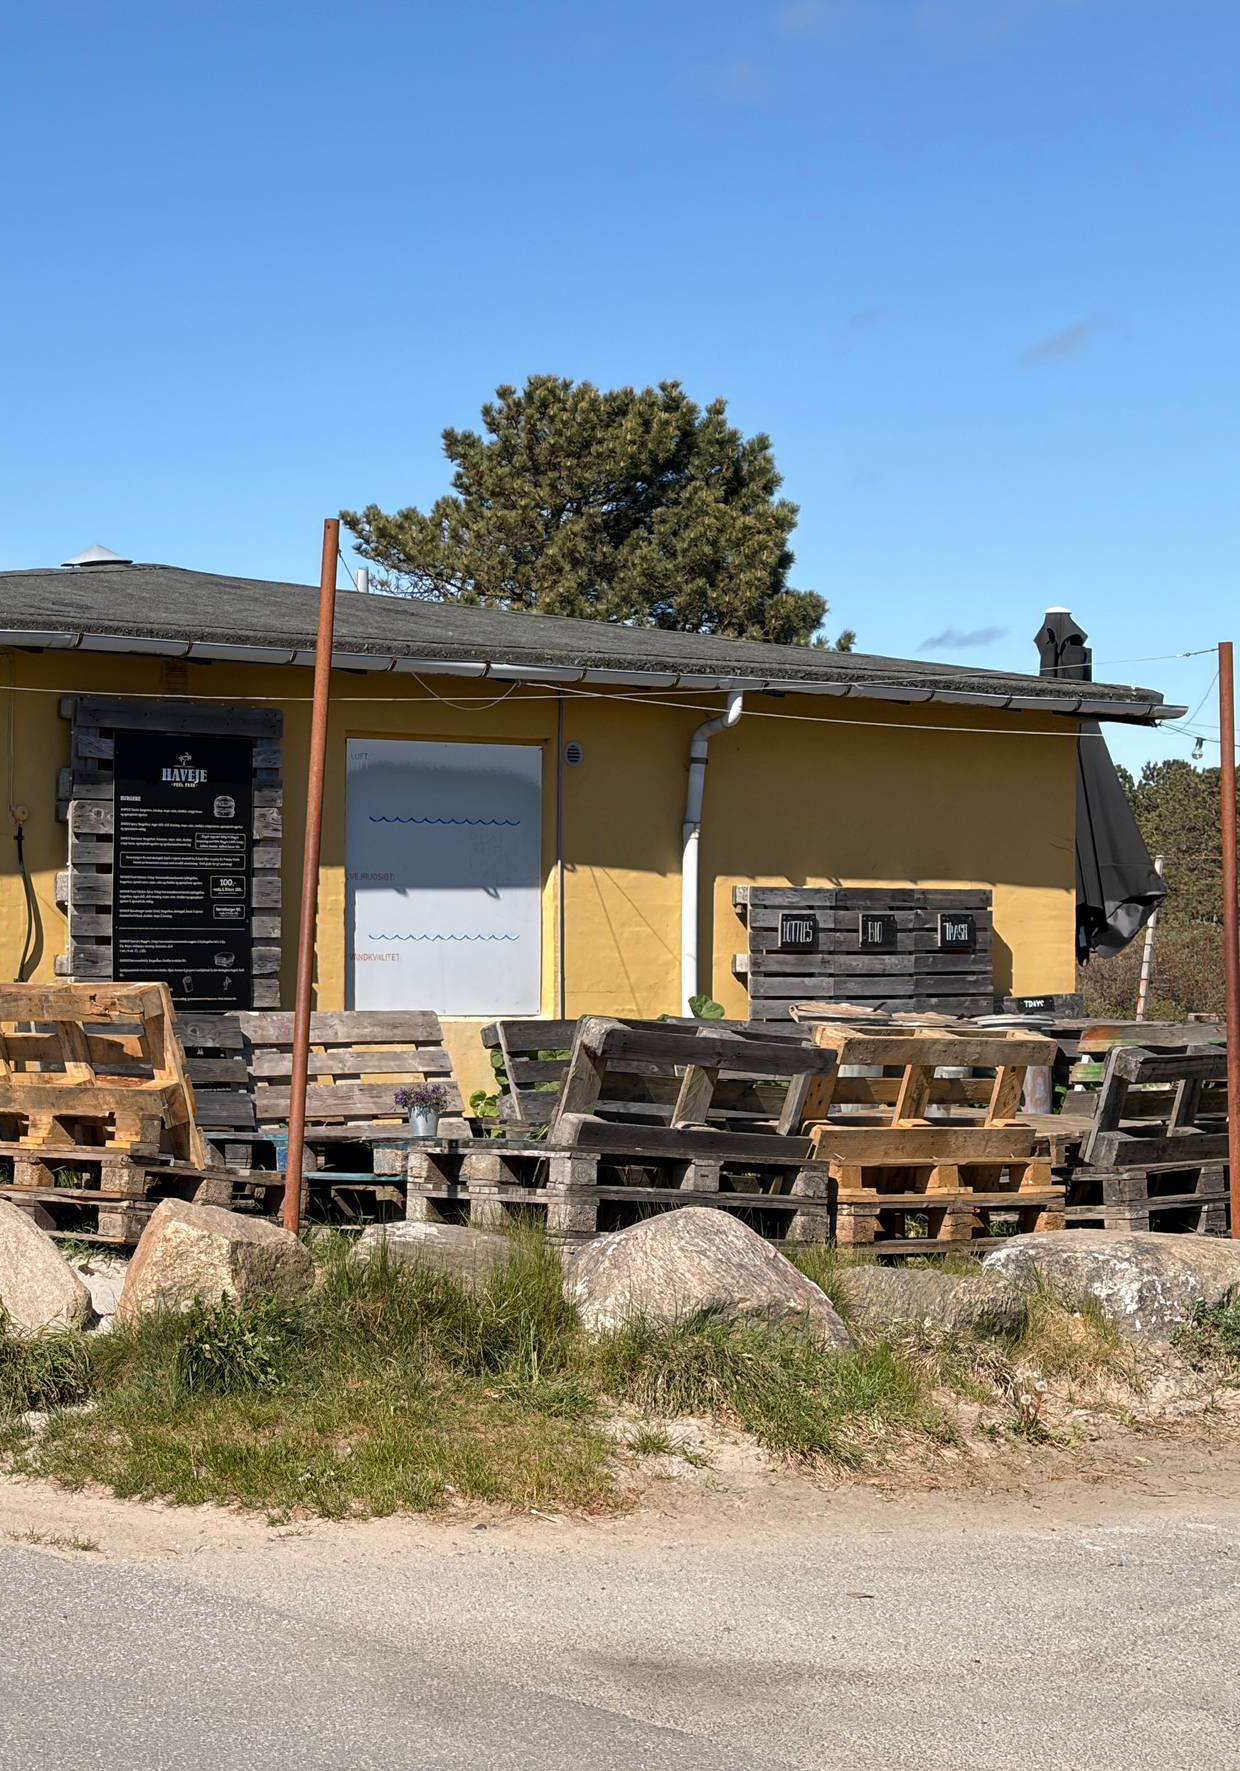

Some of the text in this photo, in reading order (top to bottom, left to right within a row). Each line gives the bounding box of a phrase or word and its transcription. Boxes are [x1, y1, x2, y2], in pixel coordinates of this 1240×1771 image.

[349, 752, 369, 761] LUFT
[161, 767, 209, 784] HAVEJE
[868, 921, 883, 943] BIO
[943, 922, 969, 941] TRASH
